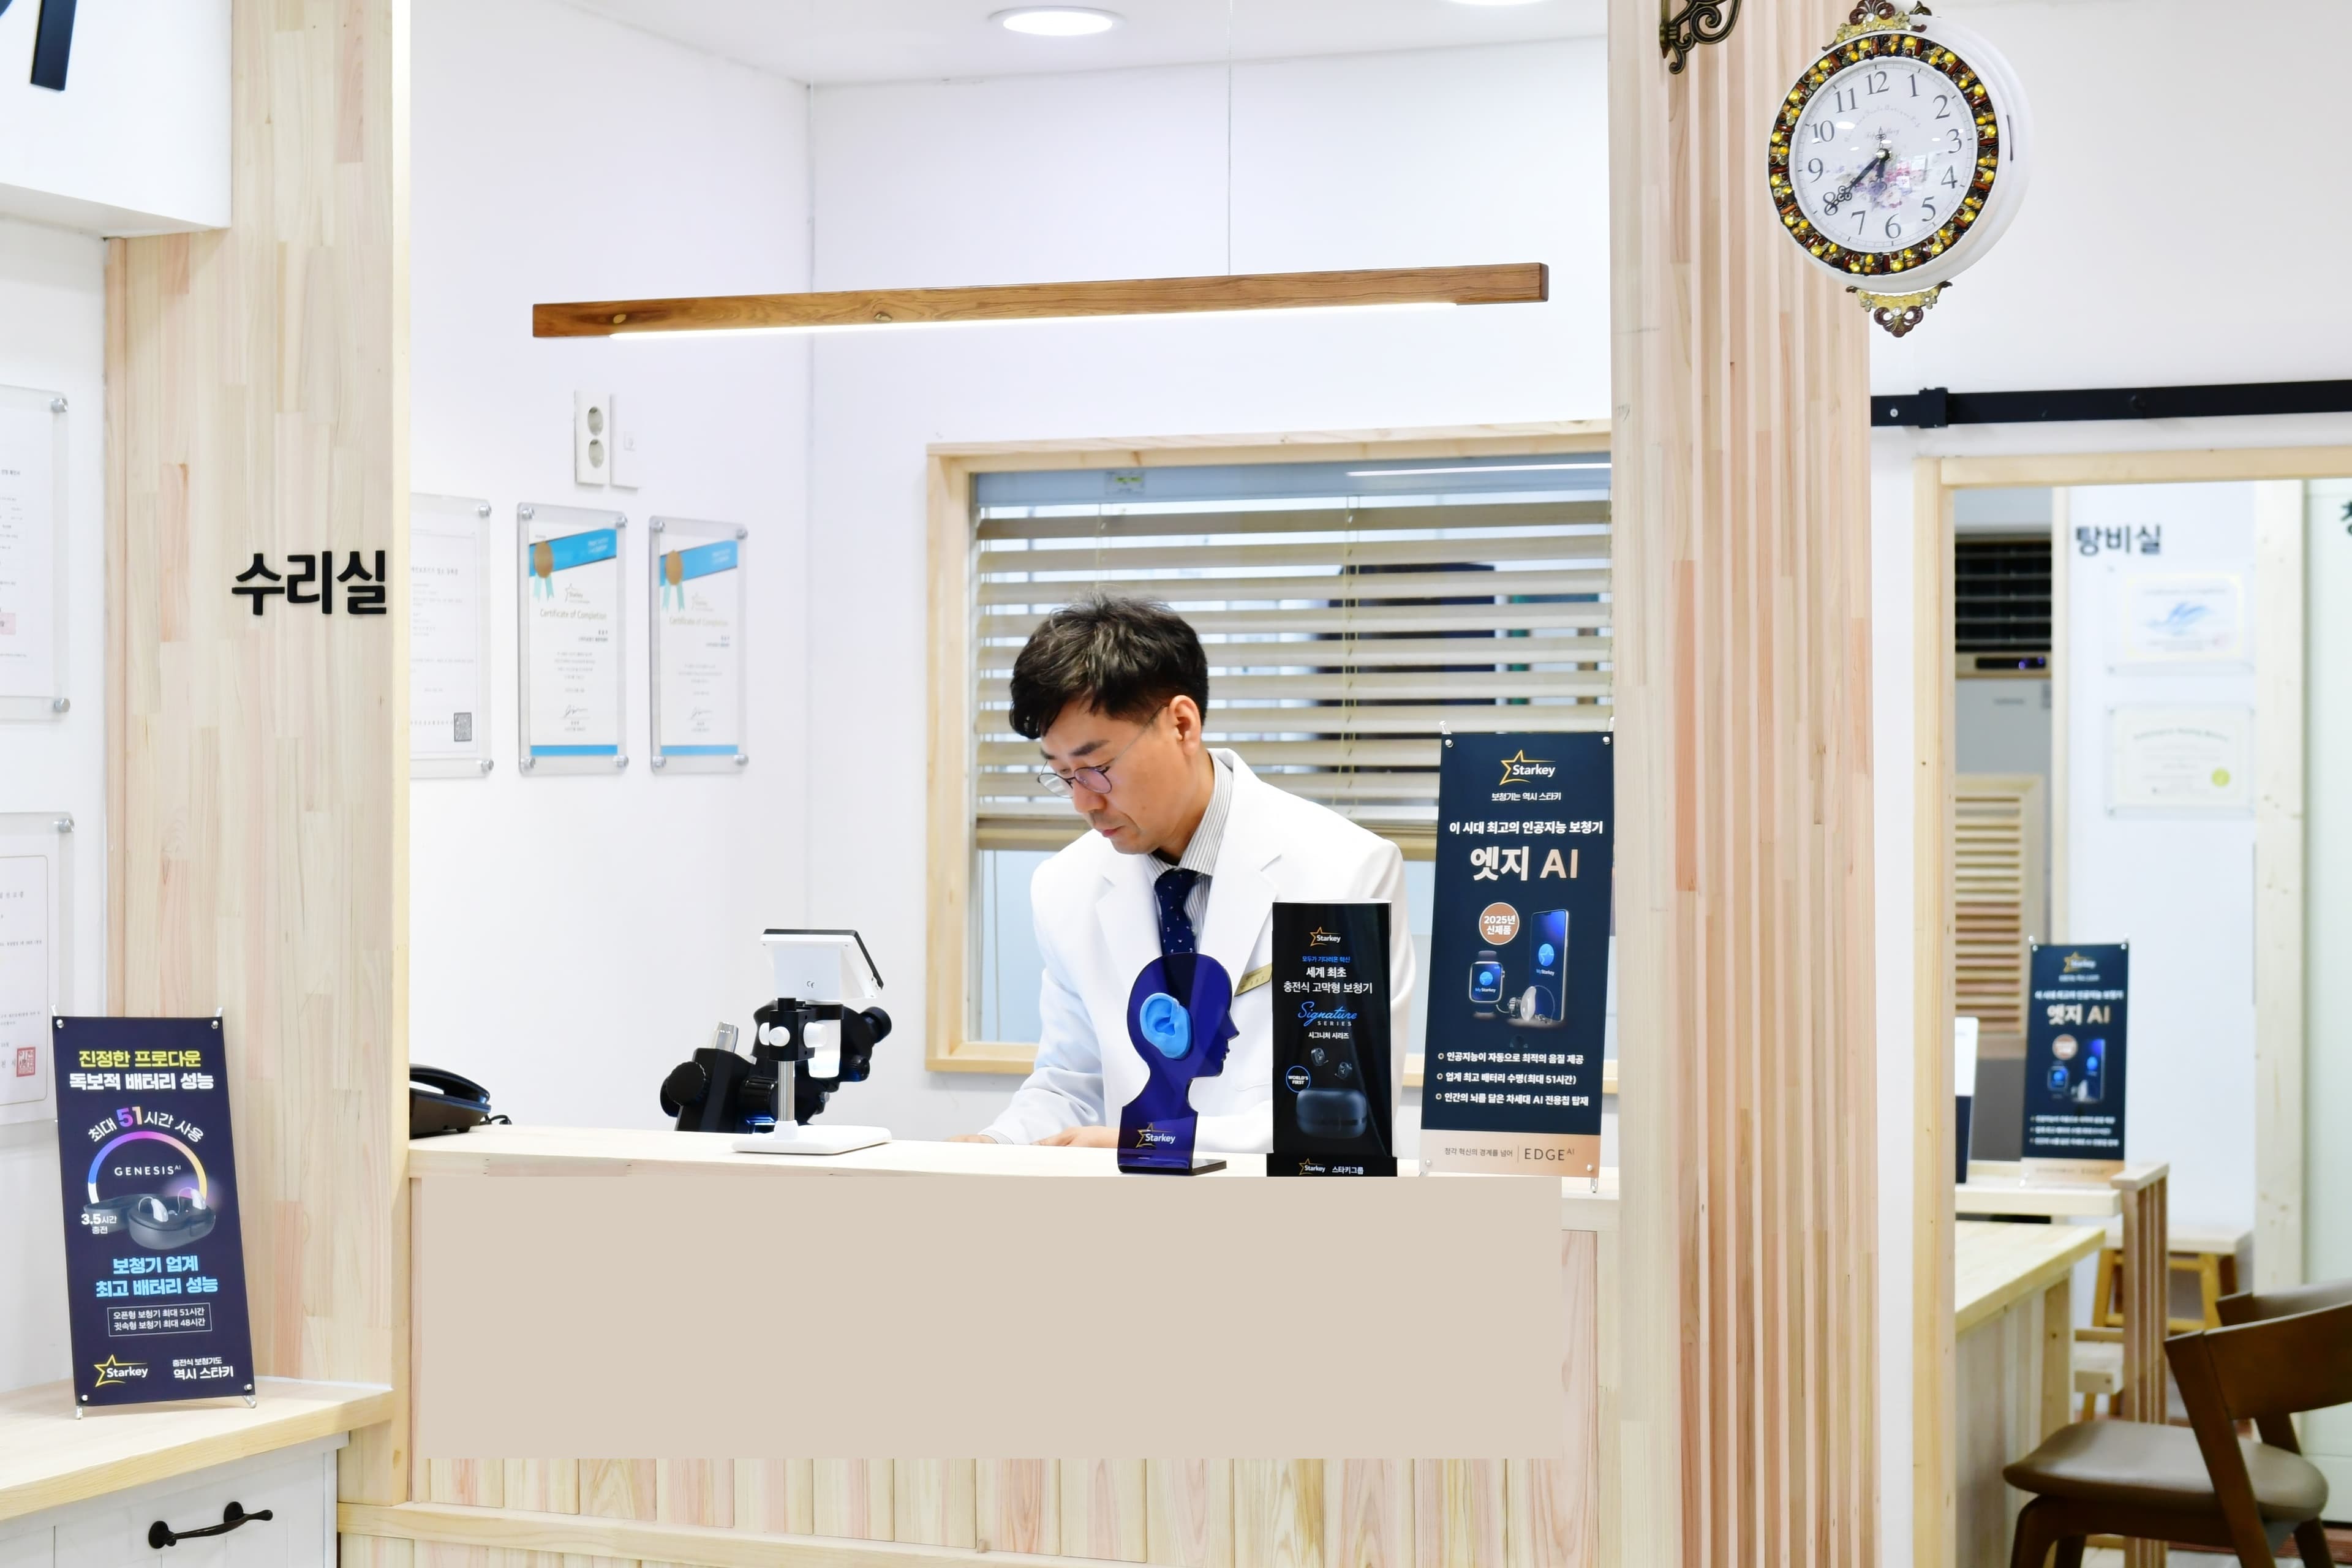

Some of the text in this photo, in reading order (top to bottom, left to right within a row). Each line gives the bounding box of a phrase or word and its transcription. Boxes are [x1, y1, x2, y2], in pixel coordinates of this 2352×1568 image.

[1864, 71, 1890, 96] 12
[1907, 74, 1920, 97] 1
[1834, 88, 1858, 113] 11
[1933, 94, 1950, 119] 2
[1812, 120, 1834, 144] 10
[1946, 129, 1962, 154] 3
[1808, 158, 1823, 183] 9
[1940, 165, 1958, 189] 4
[1823, 192, 1838, 216] 8
[1921, 196, 1936, 221] 5
[1851, 210, 1866, 235] 7
[1885, 213, 1901, 239] 6
[2076, 525, 2160, 556] 탕비실
[232, 550, 387, 616] 수리실
[1512, 764, 1555, 777] Starkey
[1491, 793, 1521, 801] 보청기는
[1539, 792, 1561, 801] 스타키
[1449, 821, 1603, 834] 이 시대 최고의 인공지능 보청기
[1470, 846, 1578, 881] 엣지 AI
[1484, 915, 1515, 925] 2025년
[1487, 925, 1512, 935] 신제품
[1306, 967, 1347, 978] 세계 최초
[1284, 981, 1373, 994] 충전식 고막형 보청기
[1298, 1001, 1358, 1027] Signature
[2086, 1005, 2110, 1024] AI
[79, 1050, 201, 1068] 진정한 프로다운
[1447, 1052, 1584, 1065] 인공지능이 자동으로 최적의 음질 제공
[70, 1072, 214, 1090] 독보적 배터리 성능
[1446, 1072, 1461, 1082] 업계
[1463, 1073, 1479, 1082] 최고
[1481, 1073, 1505, 1083] 배터리
[1444, 1093, 1468, 1102] 인간의
[1470, 1093, 1486, 1102] 뇌를
[1506, 1094, 1531, 1104] 차세대
[1532, 1095, 1544, 1104] AI
[88, 1118, 117, 1142] 최대
[175, 1120, 203, 1142] 사용
[1145, 1133, 1176, 1144] Starkey
[1304, 1164, 1325, 1173] Starkey
[113, 1255, 198, 1275] 보청기 업계
[96, 1276, 218, 1297] 최고 배터리 성능
[138, 1310, 160, 1319] 보청기
[162, 1309, 178, 1317] 최대
[179, 1307, 205, 1317] 51시간
[138, 1321, 161, 1329] 보청기
[164, 1319, 178, 1328] 최대
[180, 1317, 205, 1327] 48시간
[195, 1357, 222, 1366] 보청기도
[107, 1366, 148, 1378] Starkey
[173, 1366, 233, 1380] 역시 스타키
